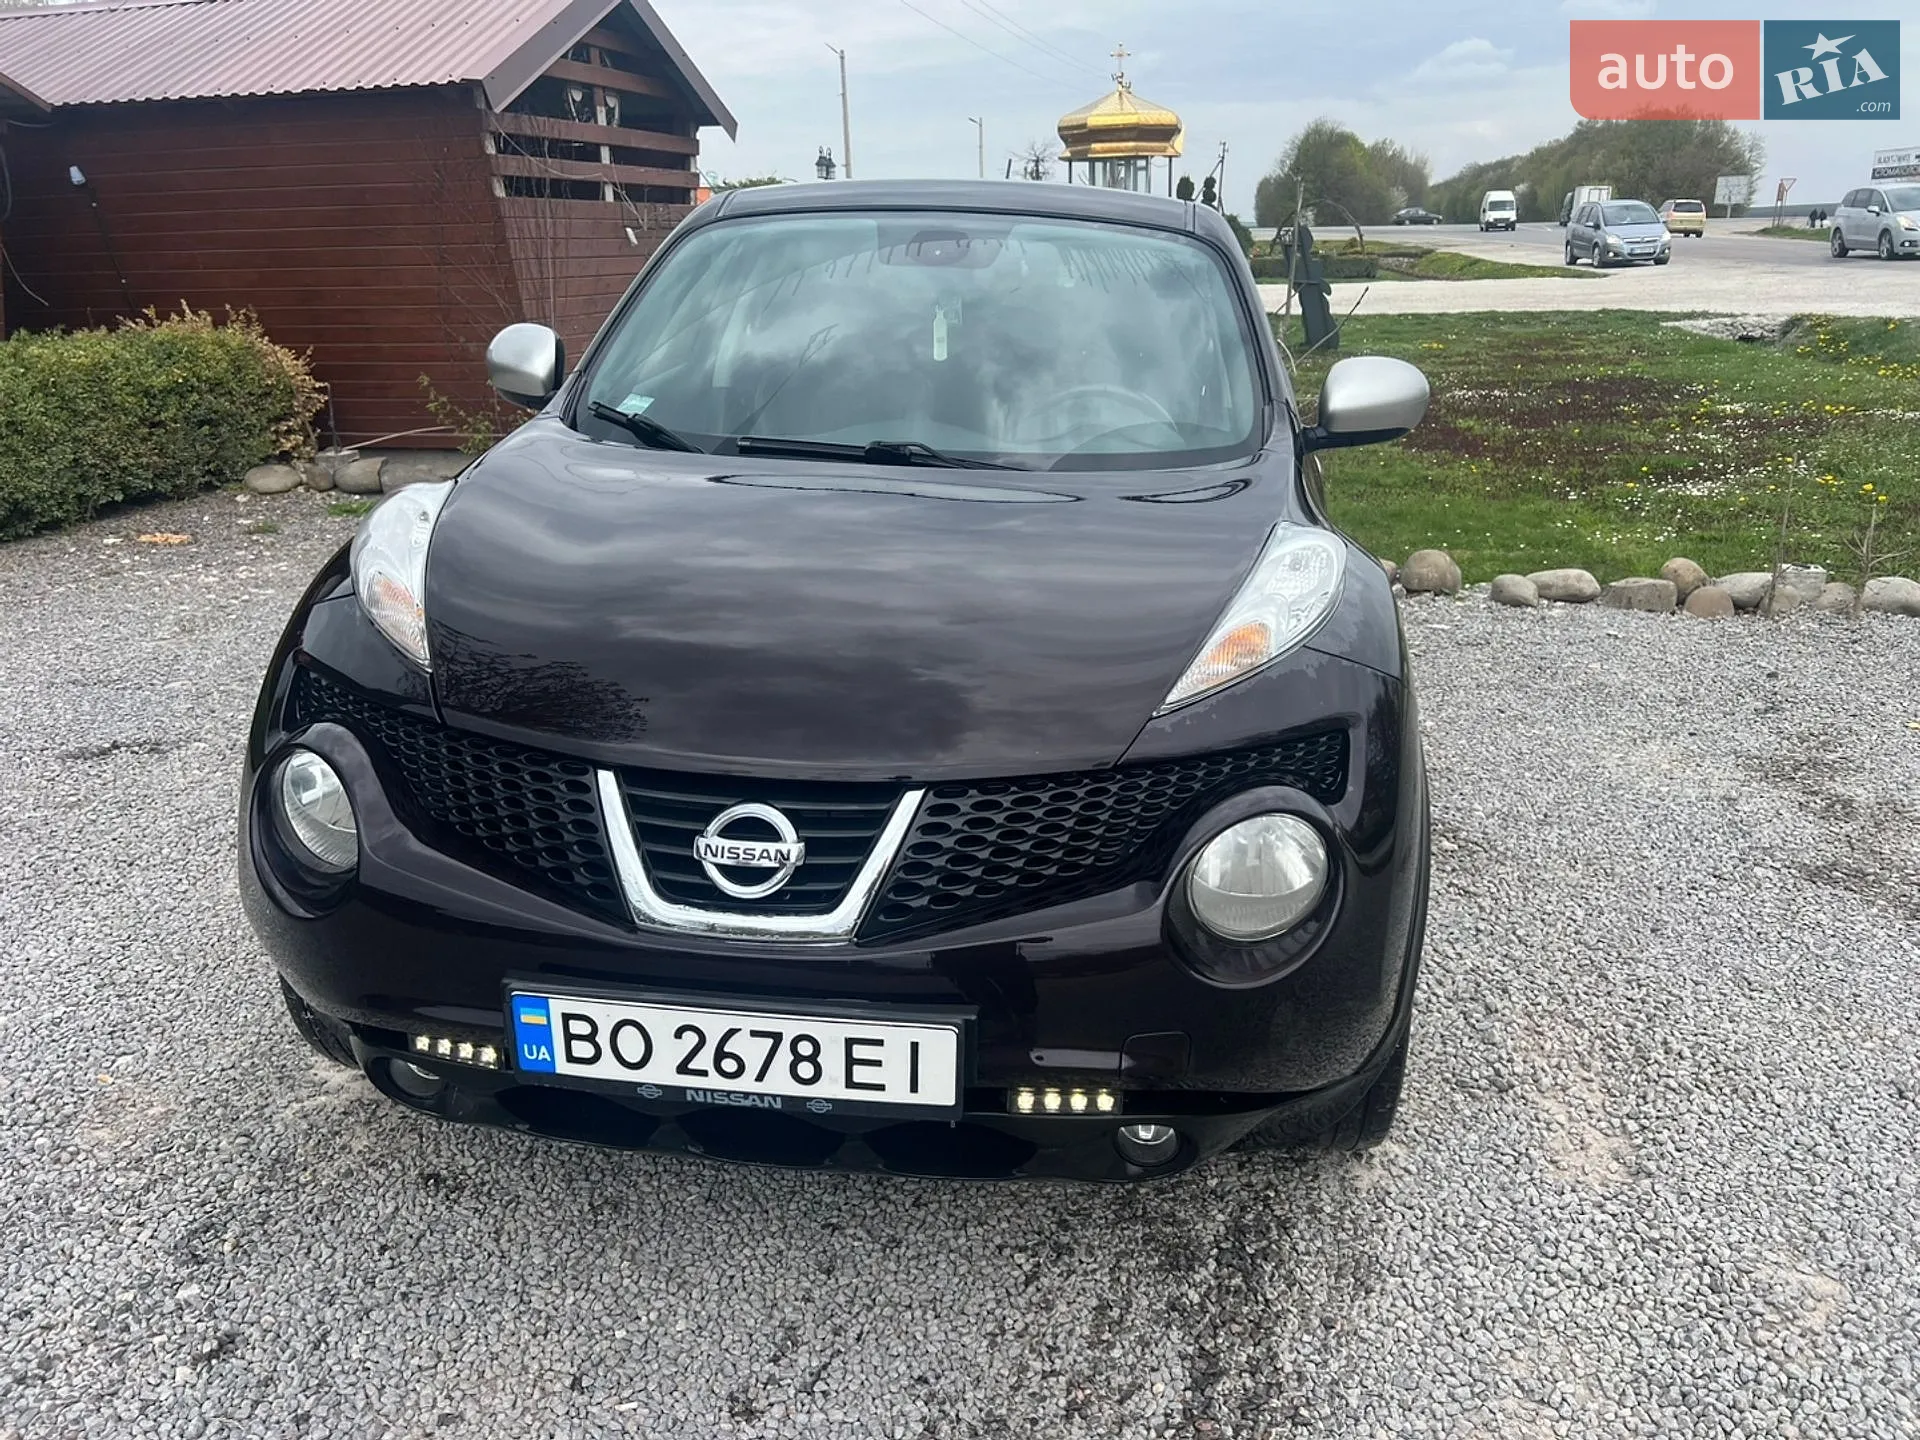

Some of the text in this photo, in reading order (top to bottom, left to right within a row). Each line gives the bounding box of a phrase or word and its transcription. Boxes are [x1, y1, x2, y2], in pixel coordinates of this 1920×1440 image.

[703, 842, 792, 863] NISSAN
[523, 1042, 552, 1063] UA
[561, 1011, 920, 1095] BO 2678 EI
[685, 1088, 783, 1110] NISSAN
